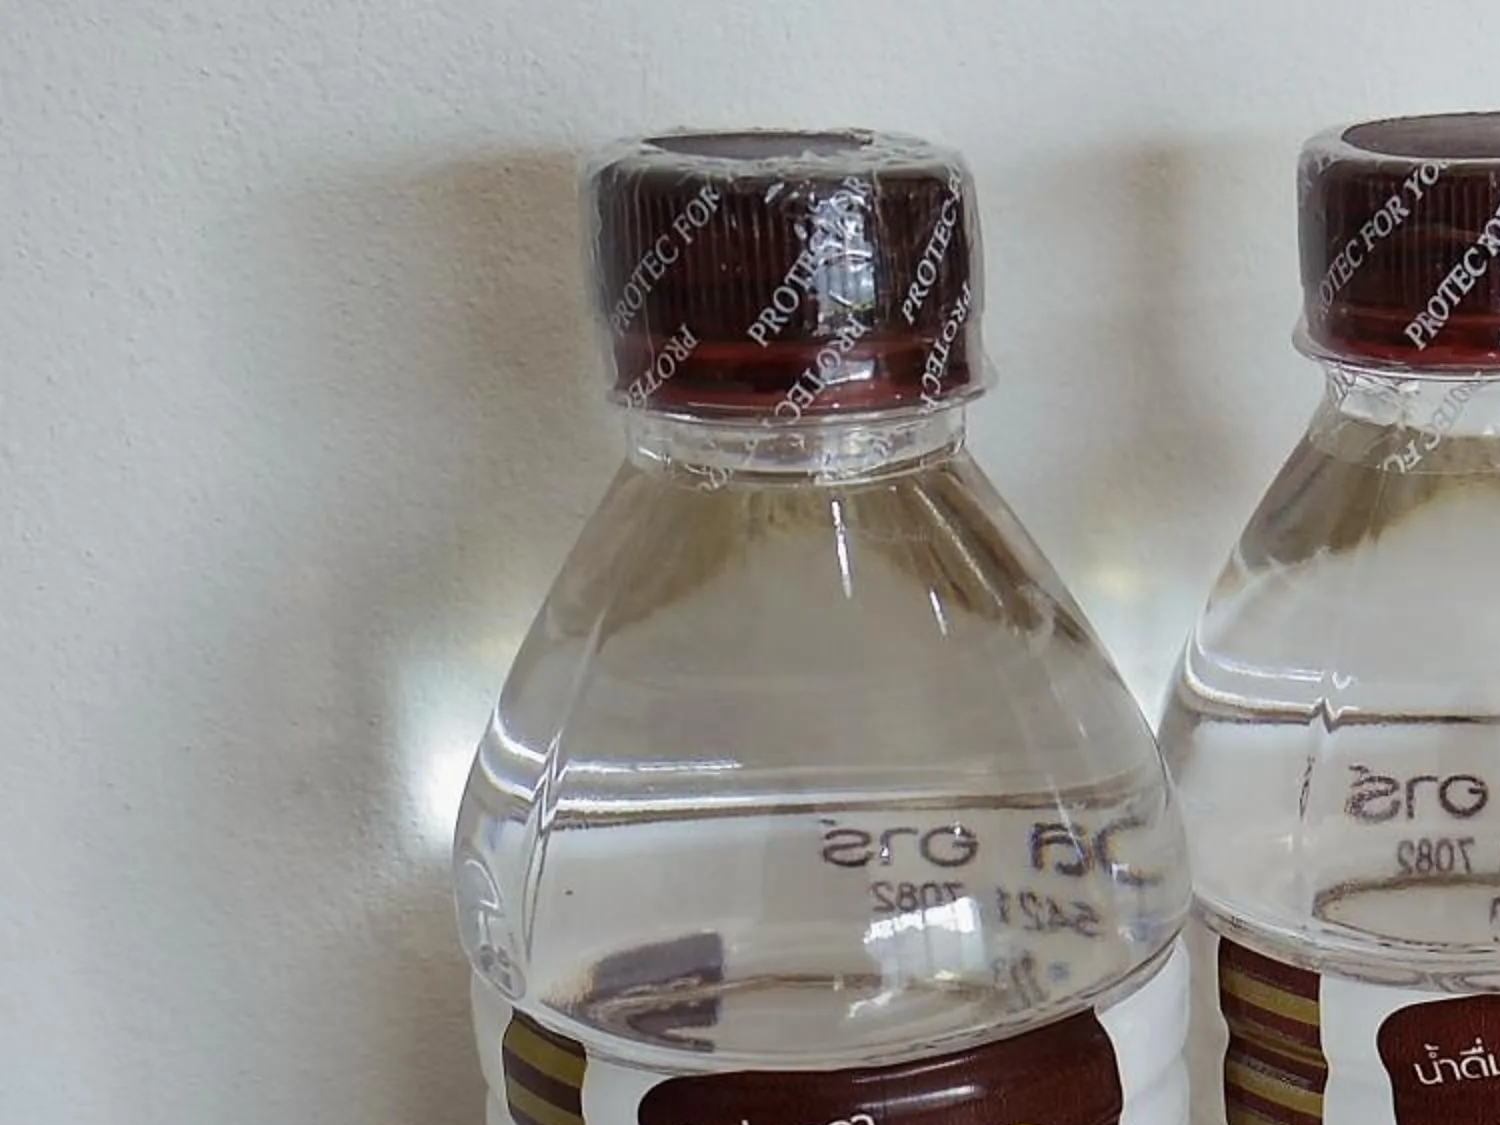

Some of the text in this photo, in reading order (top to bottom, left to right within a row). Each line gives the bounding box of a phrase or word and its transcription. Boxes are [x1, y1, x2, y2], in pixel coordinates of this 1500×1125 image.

[609, 185, 722, 336] PROTEC FOR
[902, 199, 957, 326] PROTEC
[1360, 194, 1411, 252] FOR
[1403, 246, 1488, 352] PROTEC
